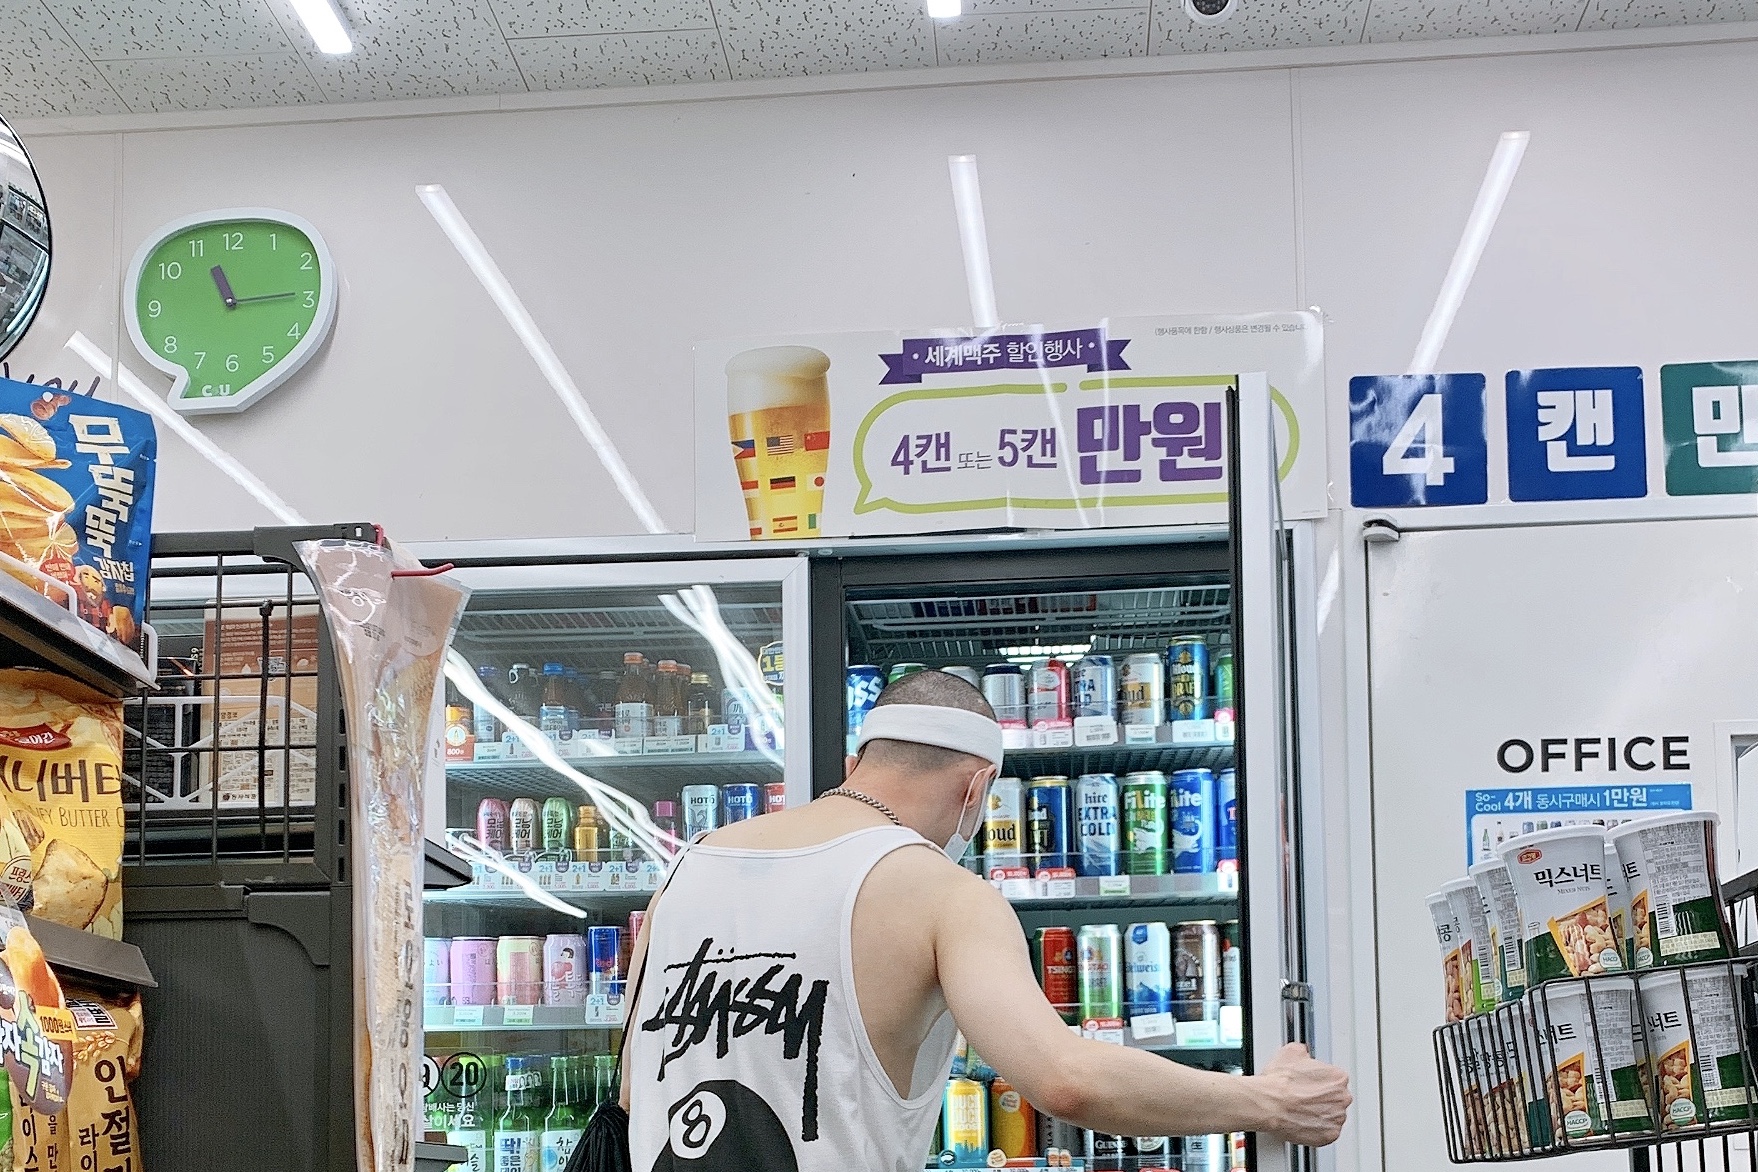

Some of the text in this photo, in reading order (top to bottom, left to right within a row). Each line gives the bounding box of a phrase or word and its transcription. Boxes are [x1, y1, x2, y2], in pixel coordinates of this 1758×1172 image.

[189, 239, 204, 257] 11
[223, 232, 244, 250] 12
[269, 233, 277, 250] 1
[300, 252, 313, 270] 2
[158, 262, 182, 280] 10
[148, 300, 161, 317] 9
[302, 291, 315, 308] 3
[286, 323, 301, 340] 4
[164, 335, 178, 353] 8
[925, 337, 1083, 367] 세계맥주 할인행사
[194, 352, 207, 369] 7
[226, 355, 239, 372] 6
[261, 346, 275, 364] 5
[890, 402, 1224, 486] 4캔 또는 5캔 만원
[1382, 393, 1455, 486] 4
[1536, 389, 1616, 472] 캔
[1496, 736, 1691, 774] OFFICE
[1475, 792, 1497, 802] So-
[1504, 791, 1533, 810] 4개
[1536, 793, 1601, 809] 동시구매시
[1603, 787, 1648, 807] 1만원
[1078, 807, 1117, 820] EXTRA
[1475, 801, 1501, 812] Cool
[59, 806, 110, 828] BUTTER
[1533, 863, 1602, 888] 믹스너트
[450, 1062, 479, 1087] 20
[681, 1099, 711, 1149] 8
